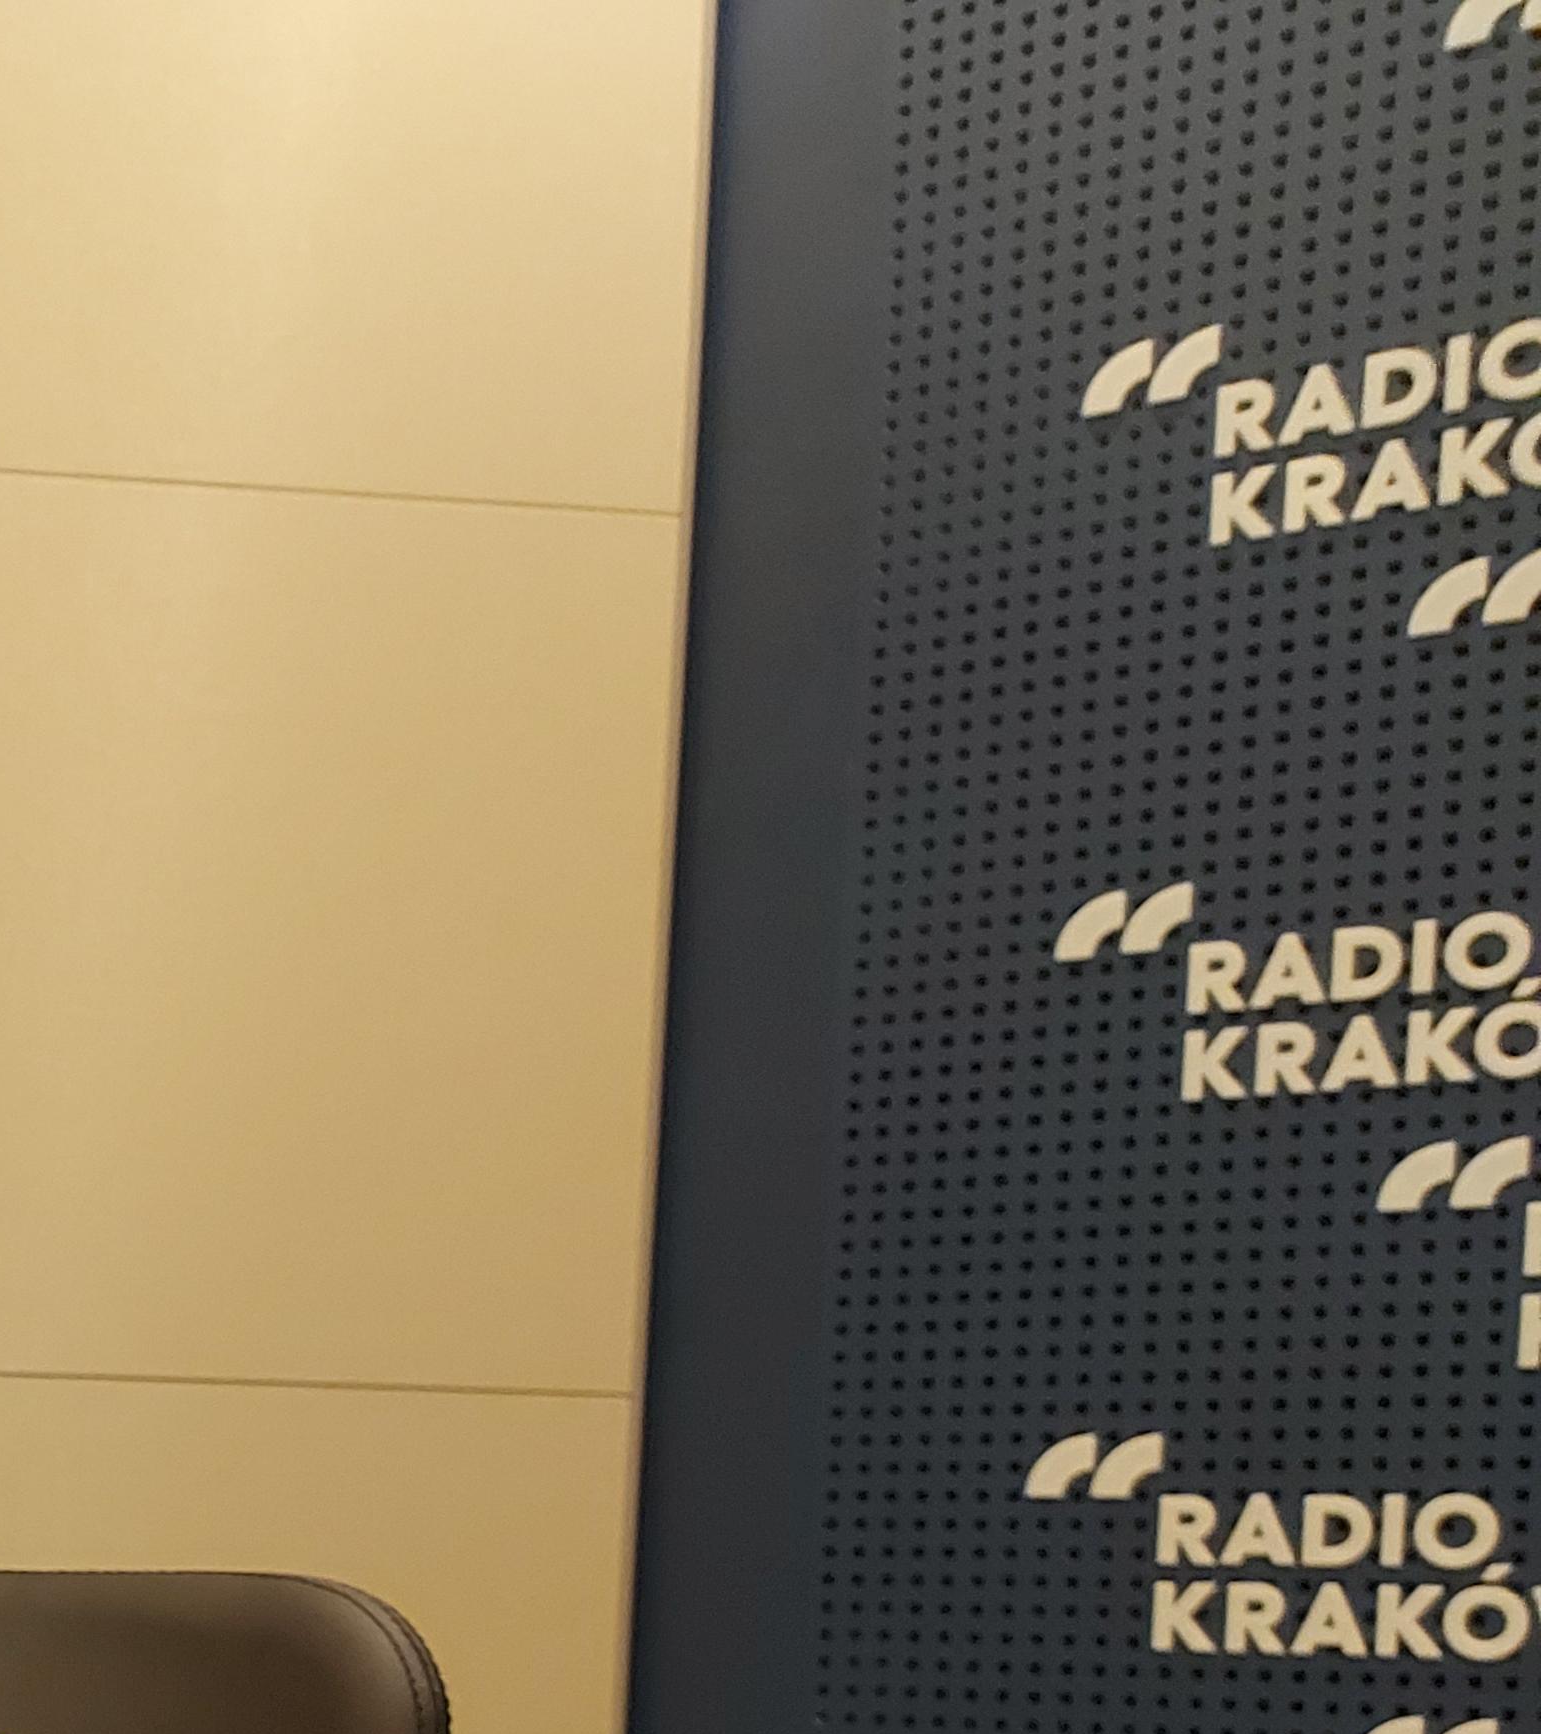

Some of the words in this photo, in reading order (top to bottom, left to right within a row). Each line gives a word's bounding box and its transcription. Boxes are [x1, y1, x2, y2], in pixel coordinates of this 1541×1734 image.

[1214, 317, 1541, 458] RADIO
[1185, 911, 1533, 1015] RADIO
[1155, 1491, 1501, 1570] RADIO
[1150, 1562, 1541, 1662] KRAKÓ
